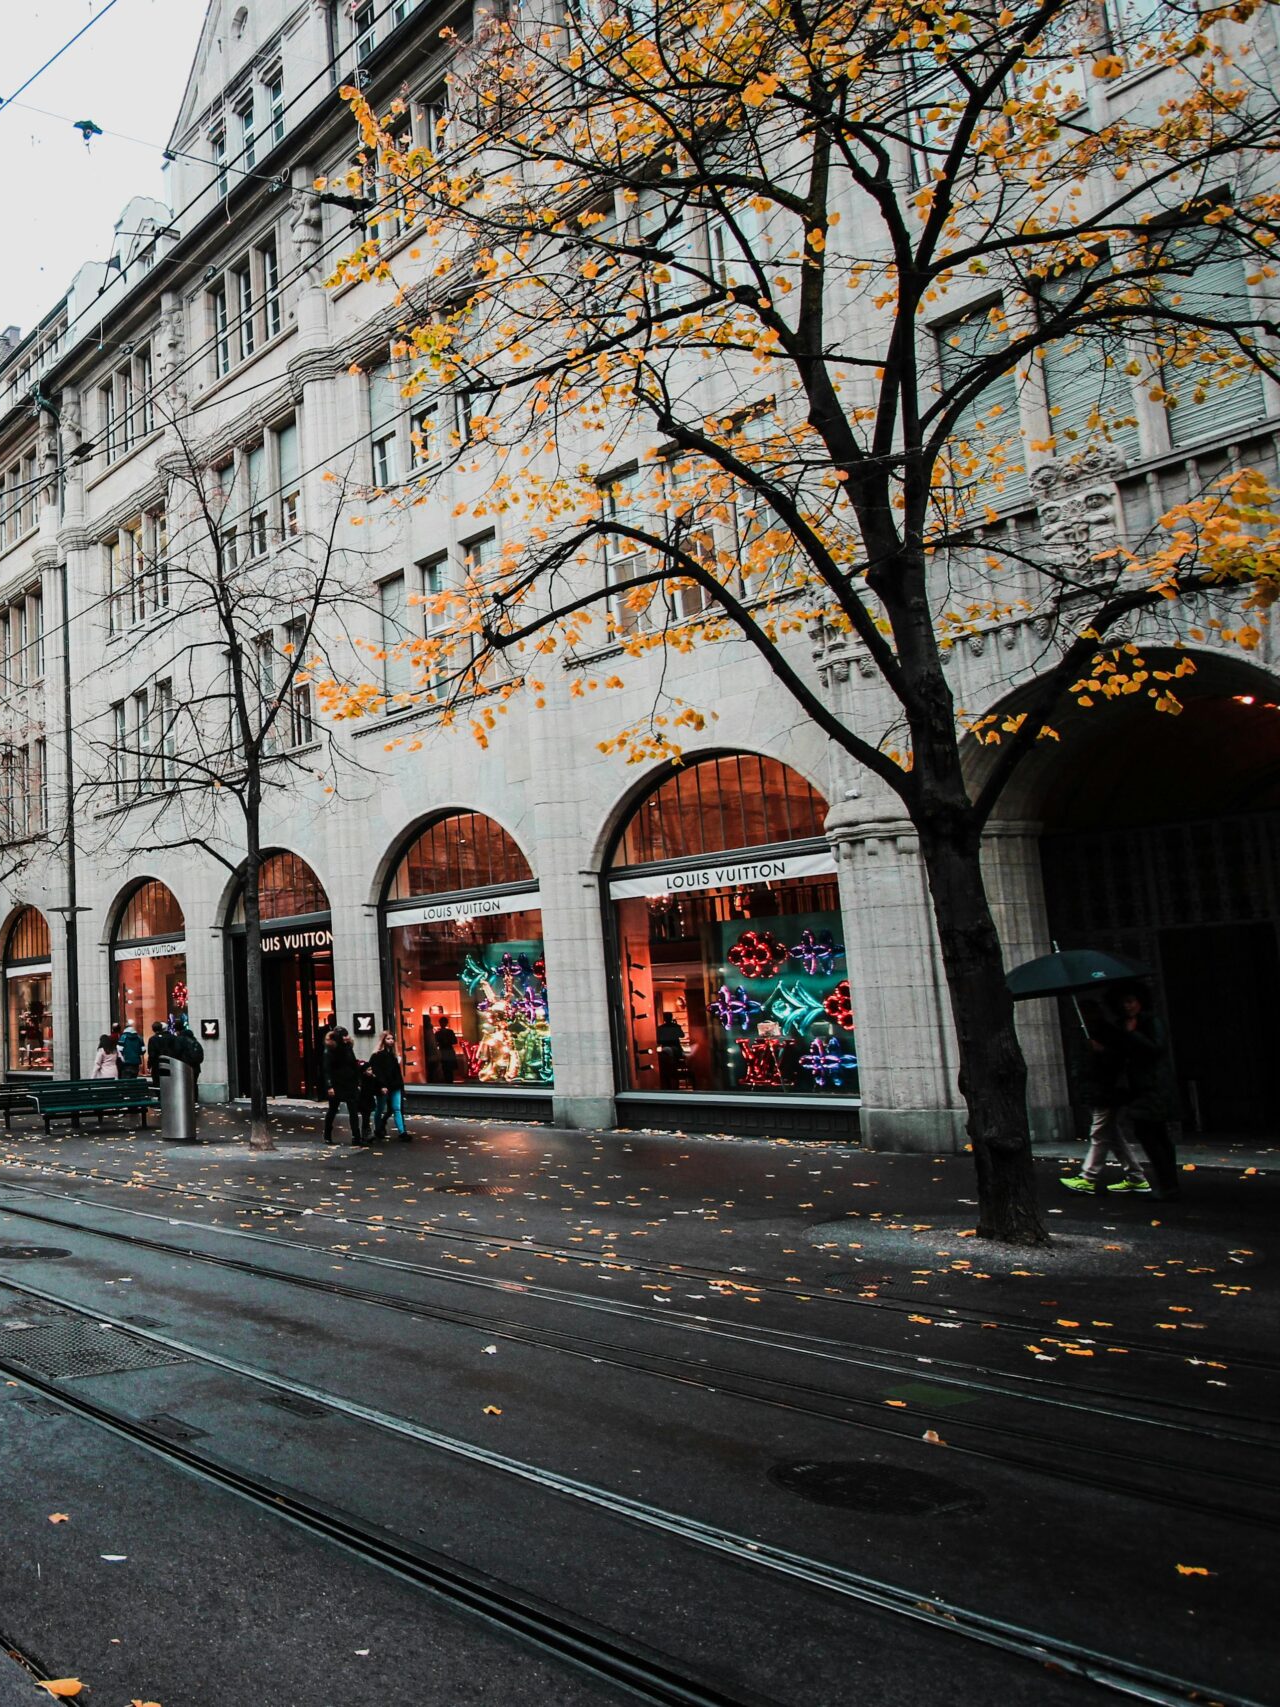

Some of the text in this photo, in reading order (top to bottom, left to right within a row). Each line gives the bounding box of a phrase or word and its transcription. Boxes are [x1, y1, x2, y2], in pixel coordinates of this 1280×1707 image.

[666, 862, 786, 889] LOUIS VUITTON
[423, 900, 501, 920] LOUIS VUITTON
[283, 930, 334, 949] VUITTON
[134, 944, 176, 956] LOUIS VUITTON
